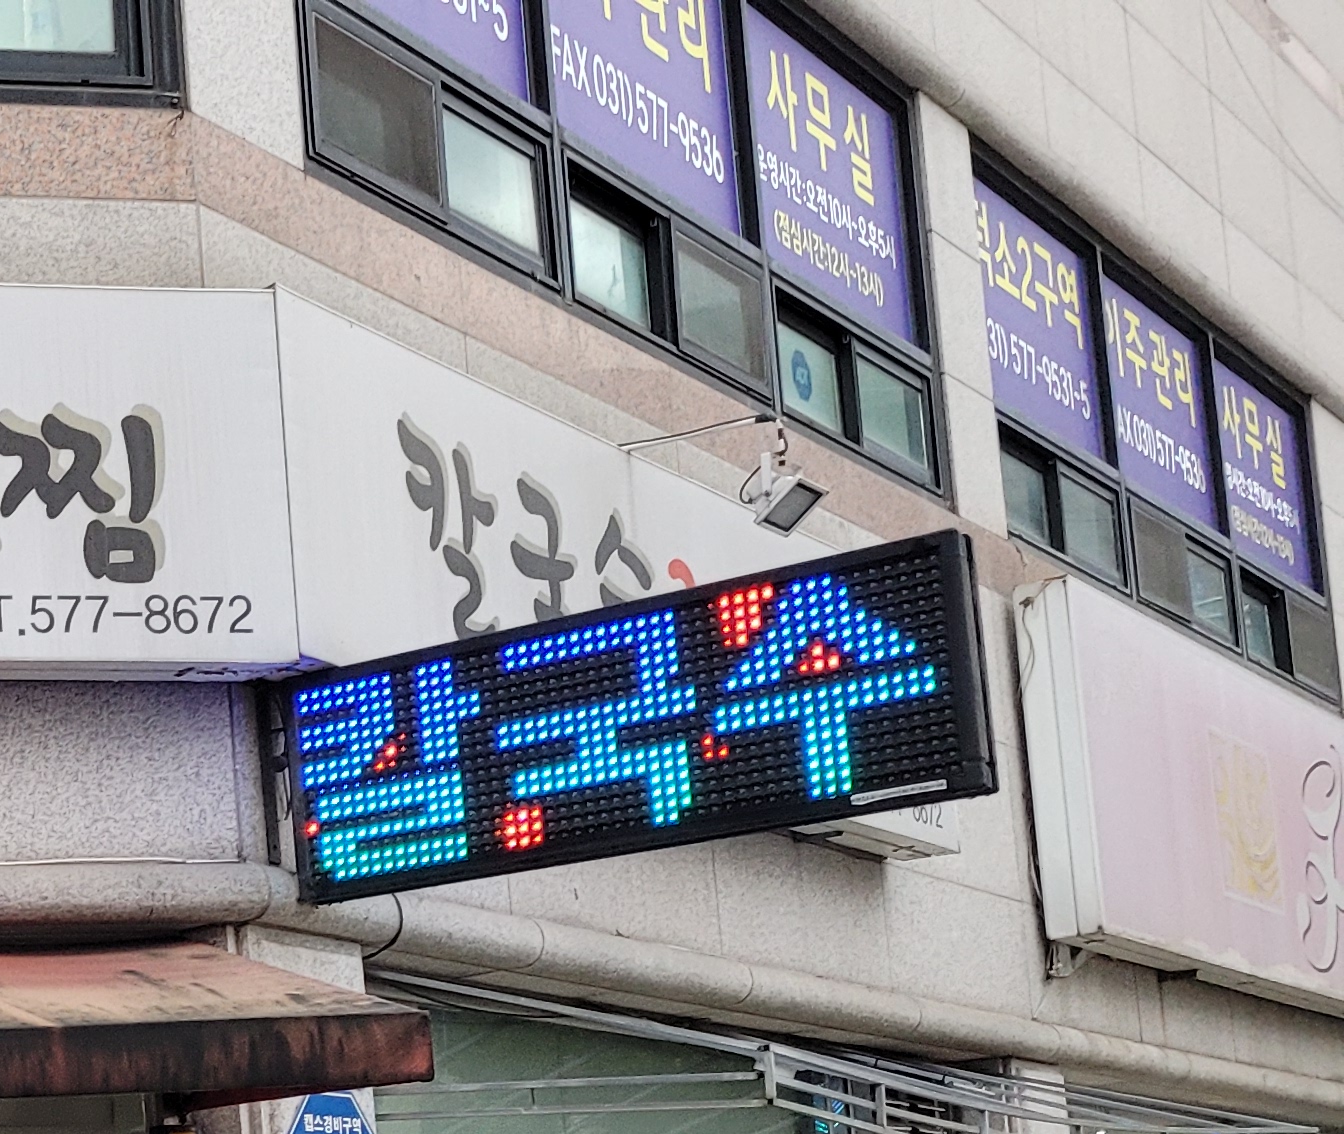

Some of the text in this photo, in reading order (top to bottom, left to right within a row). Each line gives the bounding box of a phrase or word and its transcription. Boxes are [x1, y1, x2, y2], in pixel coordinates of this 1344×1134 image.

[550, 24, 592, 97] FAX
[767, 49, 875, 207] 사무실
[1117, 403, 1134, 447] AX
[1223, 385, 1286, 490] 사무실
[298, 572, 938, 883] 칼국수
